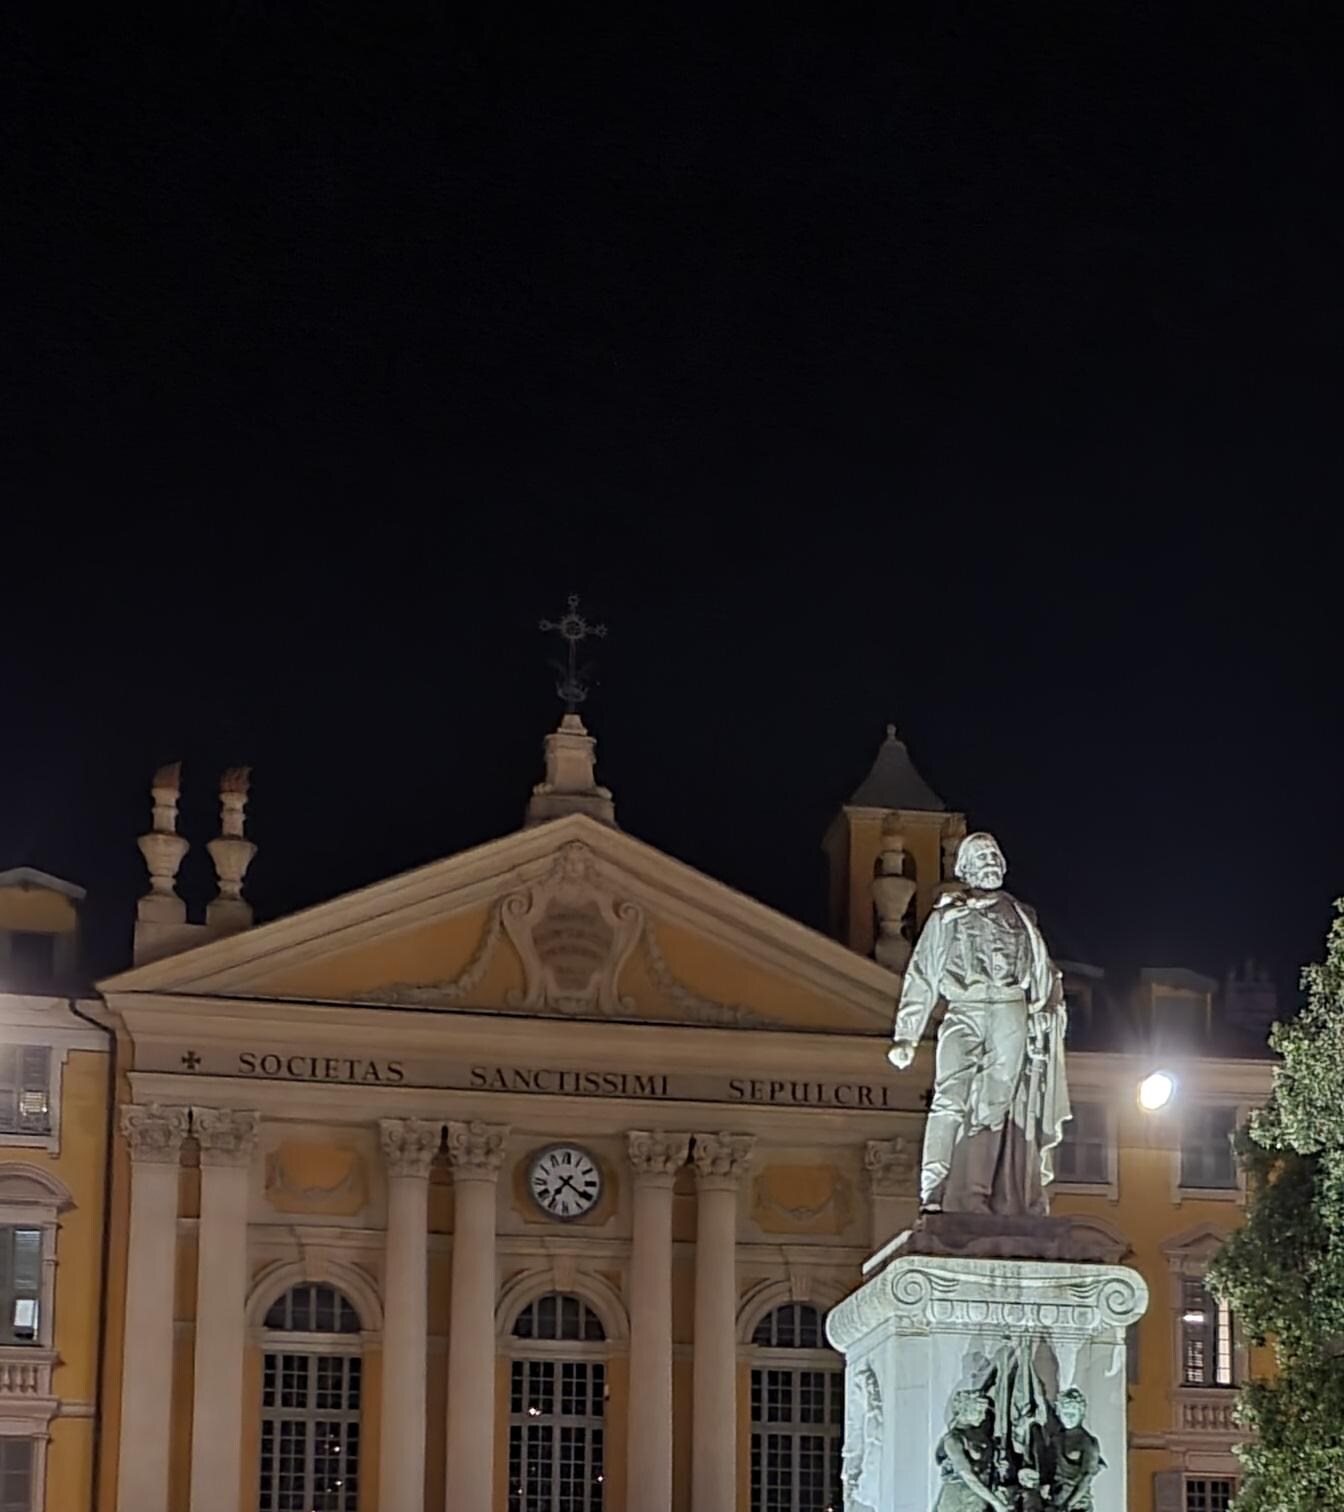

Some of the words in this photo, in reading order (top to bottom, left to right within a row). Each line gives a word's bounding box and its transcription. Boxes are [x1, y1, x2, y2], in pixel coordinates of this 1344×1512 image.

[238, 1052, 405, 1083] SOCIETAS
[469, 1065, 669, 1096] SANCTISSIMI
[728, 1079, 889, 1107] SEPULCRI
